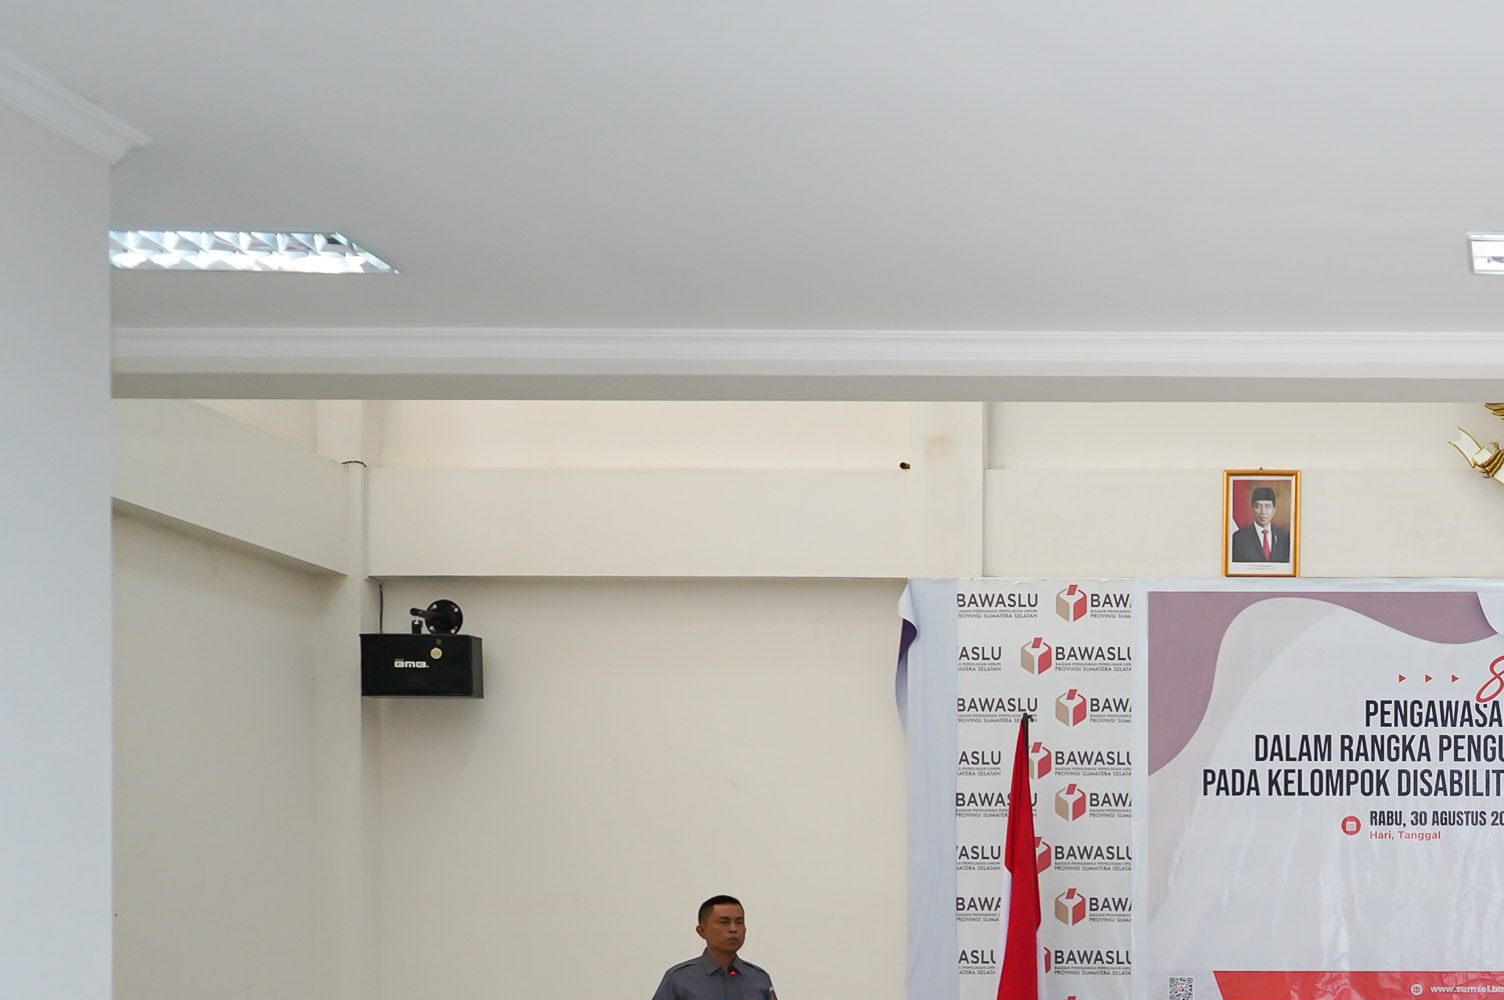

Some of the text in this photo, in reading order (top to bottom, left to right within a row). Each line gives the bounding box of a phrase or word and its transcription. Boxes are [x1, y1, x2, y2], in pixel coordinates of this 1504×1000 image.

[957, 593, 1038, 608] BAWASLU
[959, 646, 1002, 661] ASLU
[957, 698, 1038, 712] BAWASLU
[1255, 734, 1332, 761] DALAM
[1340, 734, 1431, 762] RANGKA
[959, 751, 1001, 765] ASLU
[1203, 769, 1260, 796] PADA
[1268, 769, 1390, 796] KELOMPOK
[956, 792, 1037, 807] BAWAU
[1370, 811, 1406, 828] RABU,
[1410, 811, 1427, 826] 30
[1431, 811, 1486, 826] AGUSTUS
[1370, 830, 1441, 841] Hari, Tanggal
[956, 845, 1001, 860] ASLU
[956, 897, 1001, 912] BAWA
